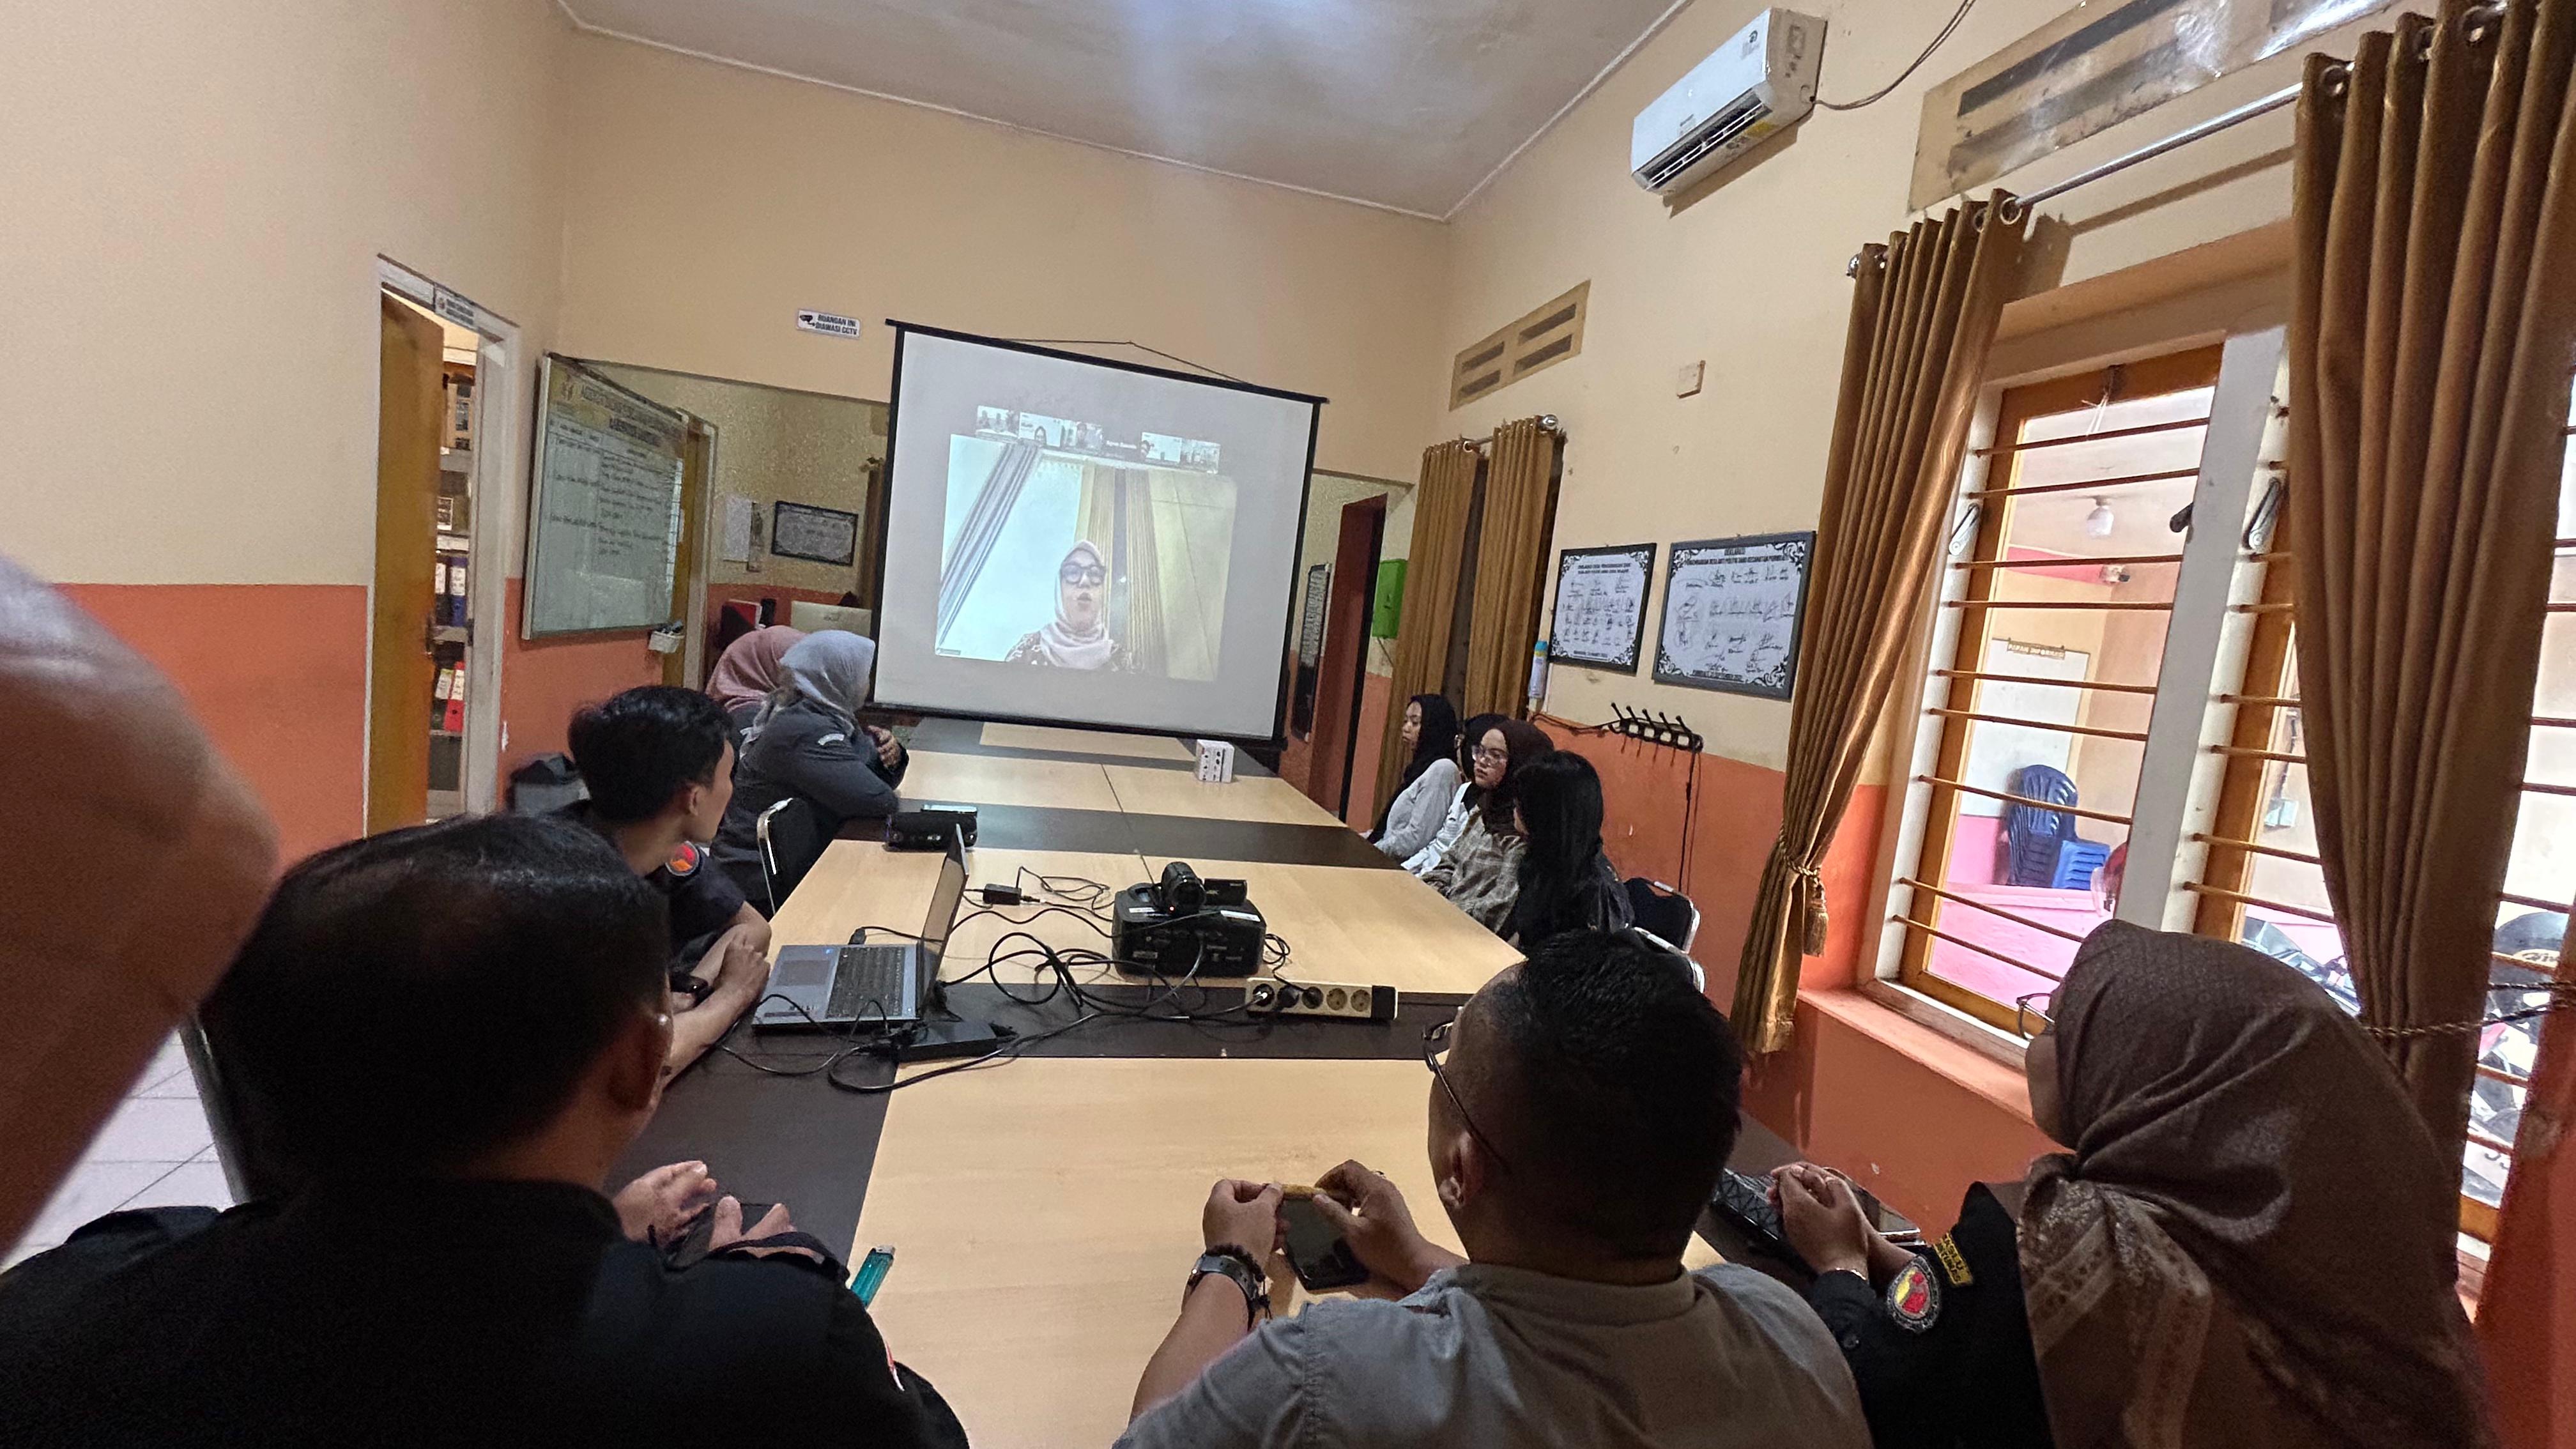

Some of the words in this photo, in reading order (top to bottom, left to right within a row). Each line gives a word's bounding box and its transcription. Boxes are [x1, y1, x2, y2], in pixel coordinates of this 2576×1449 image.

[818, 314, 847, 325] RUANGAN
[815, 322, 841, 332] DIAWASI
[2008, 643, 2029, 653] PAPAN
[2030, 647, 2065, 658] INFORMASI
